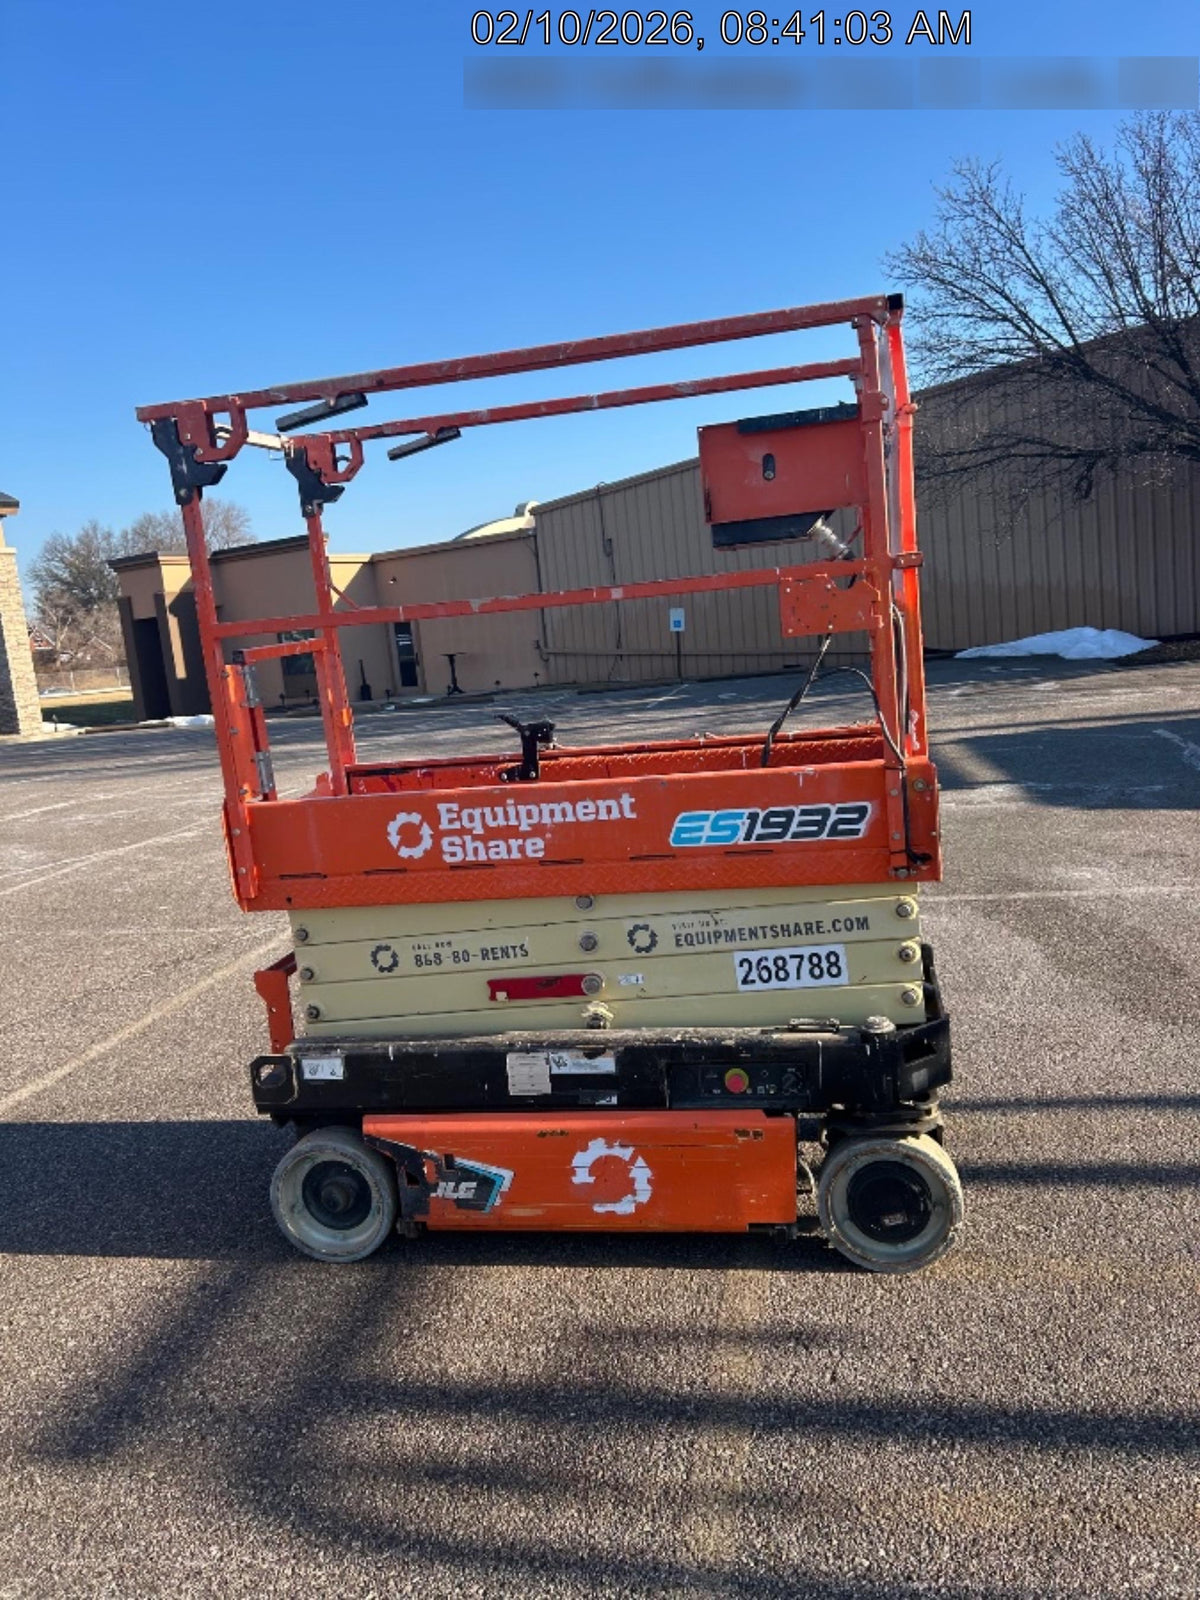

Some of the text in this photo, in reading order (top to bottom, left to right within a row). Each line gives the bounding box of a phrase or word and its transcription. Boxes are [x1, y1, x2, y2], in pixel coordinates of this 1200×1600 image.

[437, 793, 637, 834] Equipment
[669, 801, 872, 847] ES1932
[441, 835, 545, 863] Share
[675, 916, 870, 948] EQUIPMENTSHARE.COM
[738, 950, 843, 986] 268788
